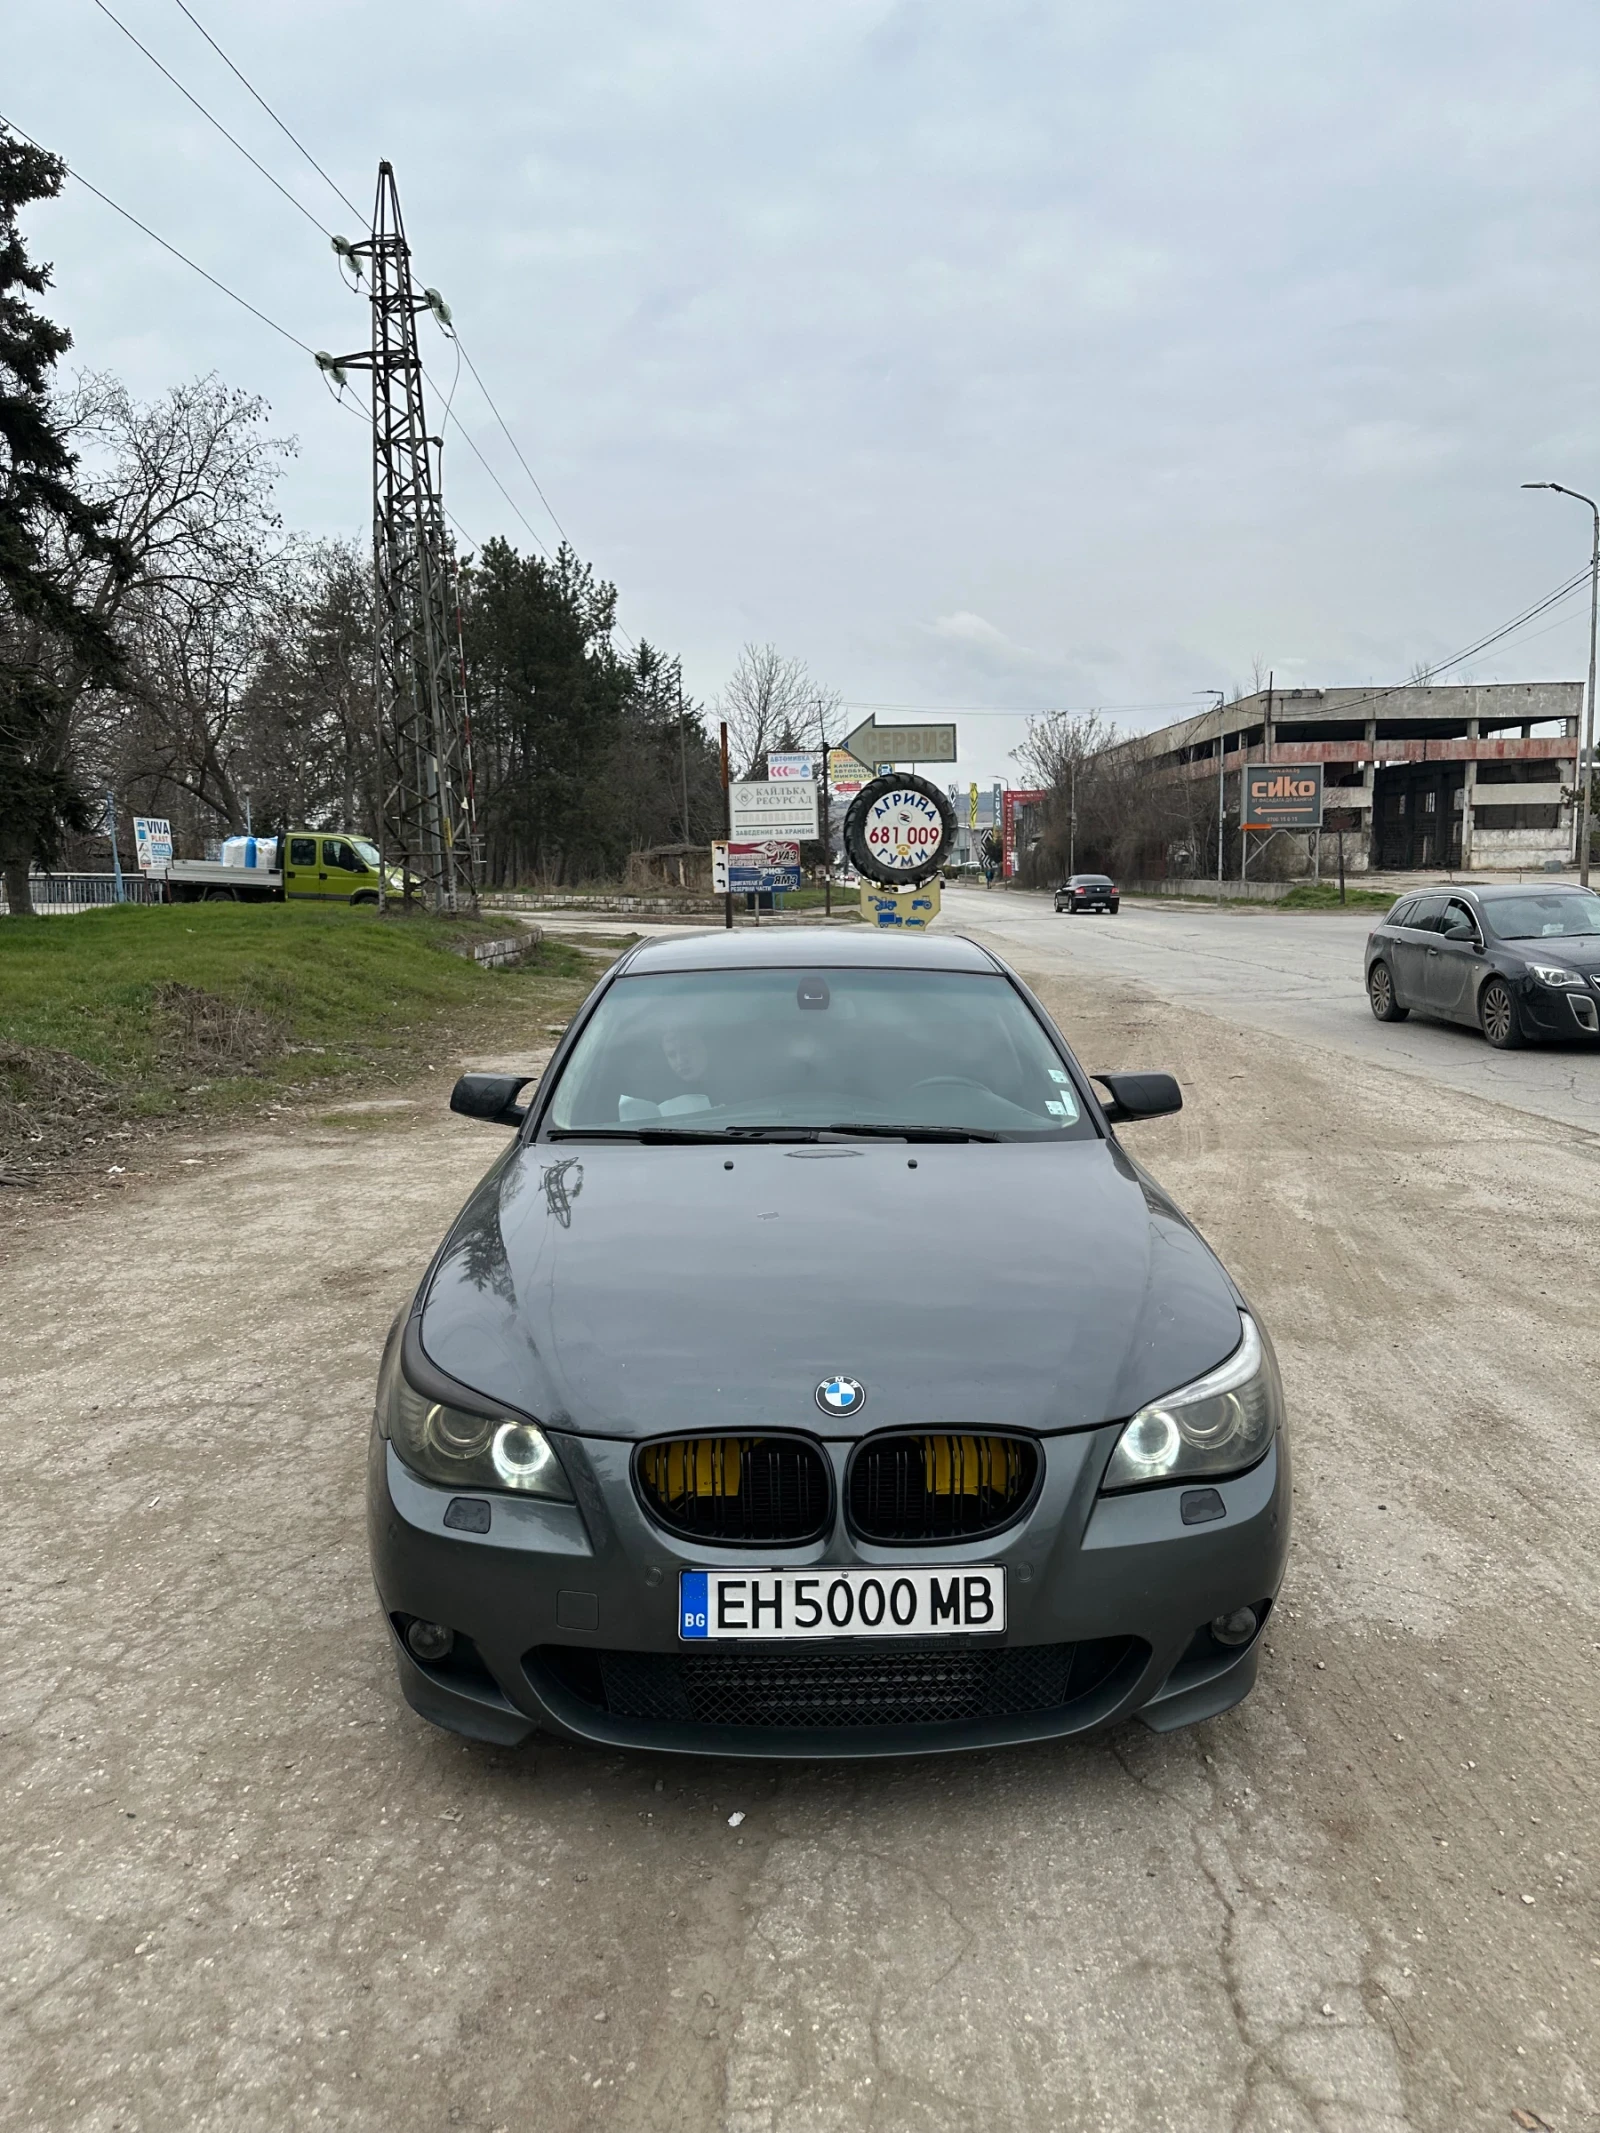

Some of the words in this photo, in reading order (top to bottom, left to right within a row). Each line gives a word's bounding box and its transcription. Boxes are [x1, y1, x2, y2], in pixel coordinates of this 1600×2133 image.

[863, 731, 952, 755] СЕРВИЗ
[756, 786, 806, 796] КАЙЛЪКА
[756, 796, 796, 805] РЕСУРС
[798, 796, 812, 805] АД
[874, 793, 936, 822] АГРИНА
[788, 812, 812, 821] БАЗА
[147, 821, 169, 835] VIVA
[736, 829, 773, 837] ЗАВЕДЕНИЕ
[785, 827, 814, 835] ХРАНЕНЕ
[869, 826, 898, 844] 681
[907, 827, 939, 844] 009
[778, 850, 797, 861] УАЗ
[876, 848, 929, 867] ГУМИ
[774, 875, 797, 885] ЯМЗ
[820, 1376, 860, 1389] BMW
[794, 1577, 917, 1628] 5000
[930, 1576, 994, 1626] MB
[684, 1613, 705, 1628] BG
